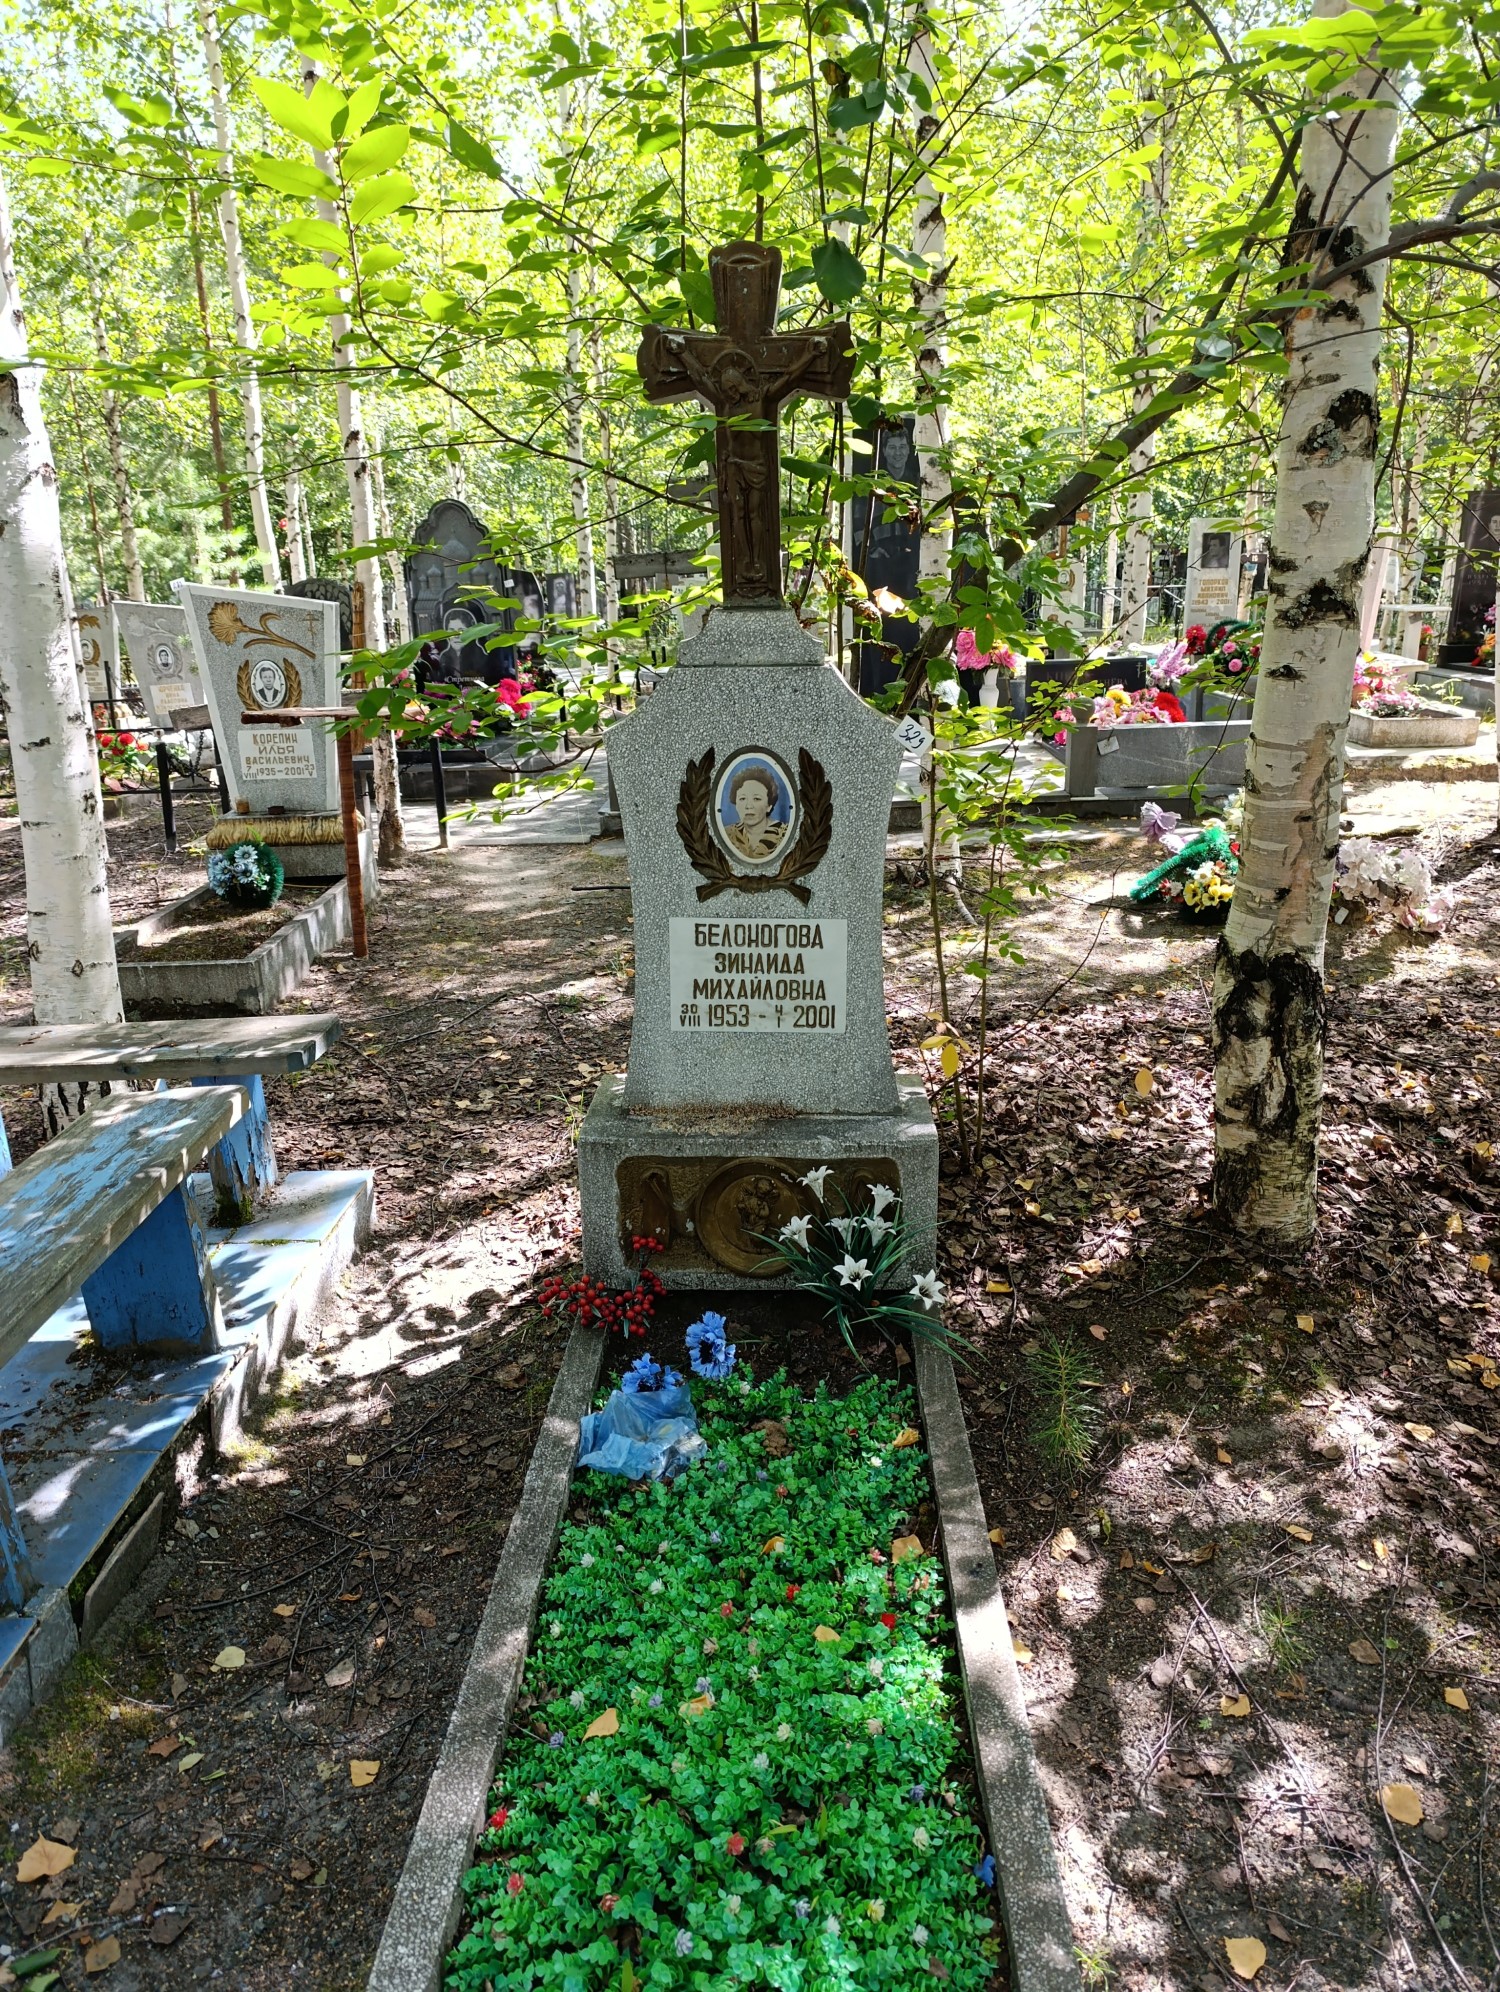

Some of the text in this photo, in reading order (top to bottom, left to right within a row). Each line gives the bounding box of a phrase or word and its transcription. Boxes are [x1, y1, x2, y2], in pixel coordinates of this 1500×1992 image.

[253, 733, 298, 744] КОРЕПИН
[899, 724, 926, 749] 329
[245, 755, 310, 765] ВАСИЛЬЕВИЧ
[259, 745, 295, 755] ИЛЬЯ
[694, 923, 824, 949] БЕЛОНОГОВА
[714, 952, 805, 975] ЗИНАИДА
[692, 976, 827, 1001] МИХАЙЛОВНА
[681, 1003, 698, 1014] 30
[708, 1004, 750, 1027] 1953
[793, 1004, 836, 1029] 2001
